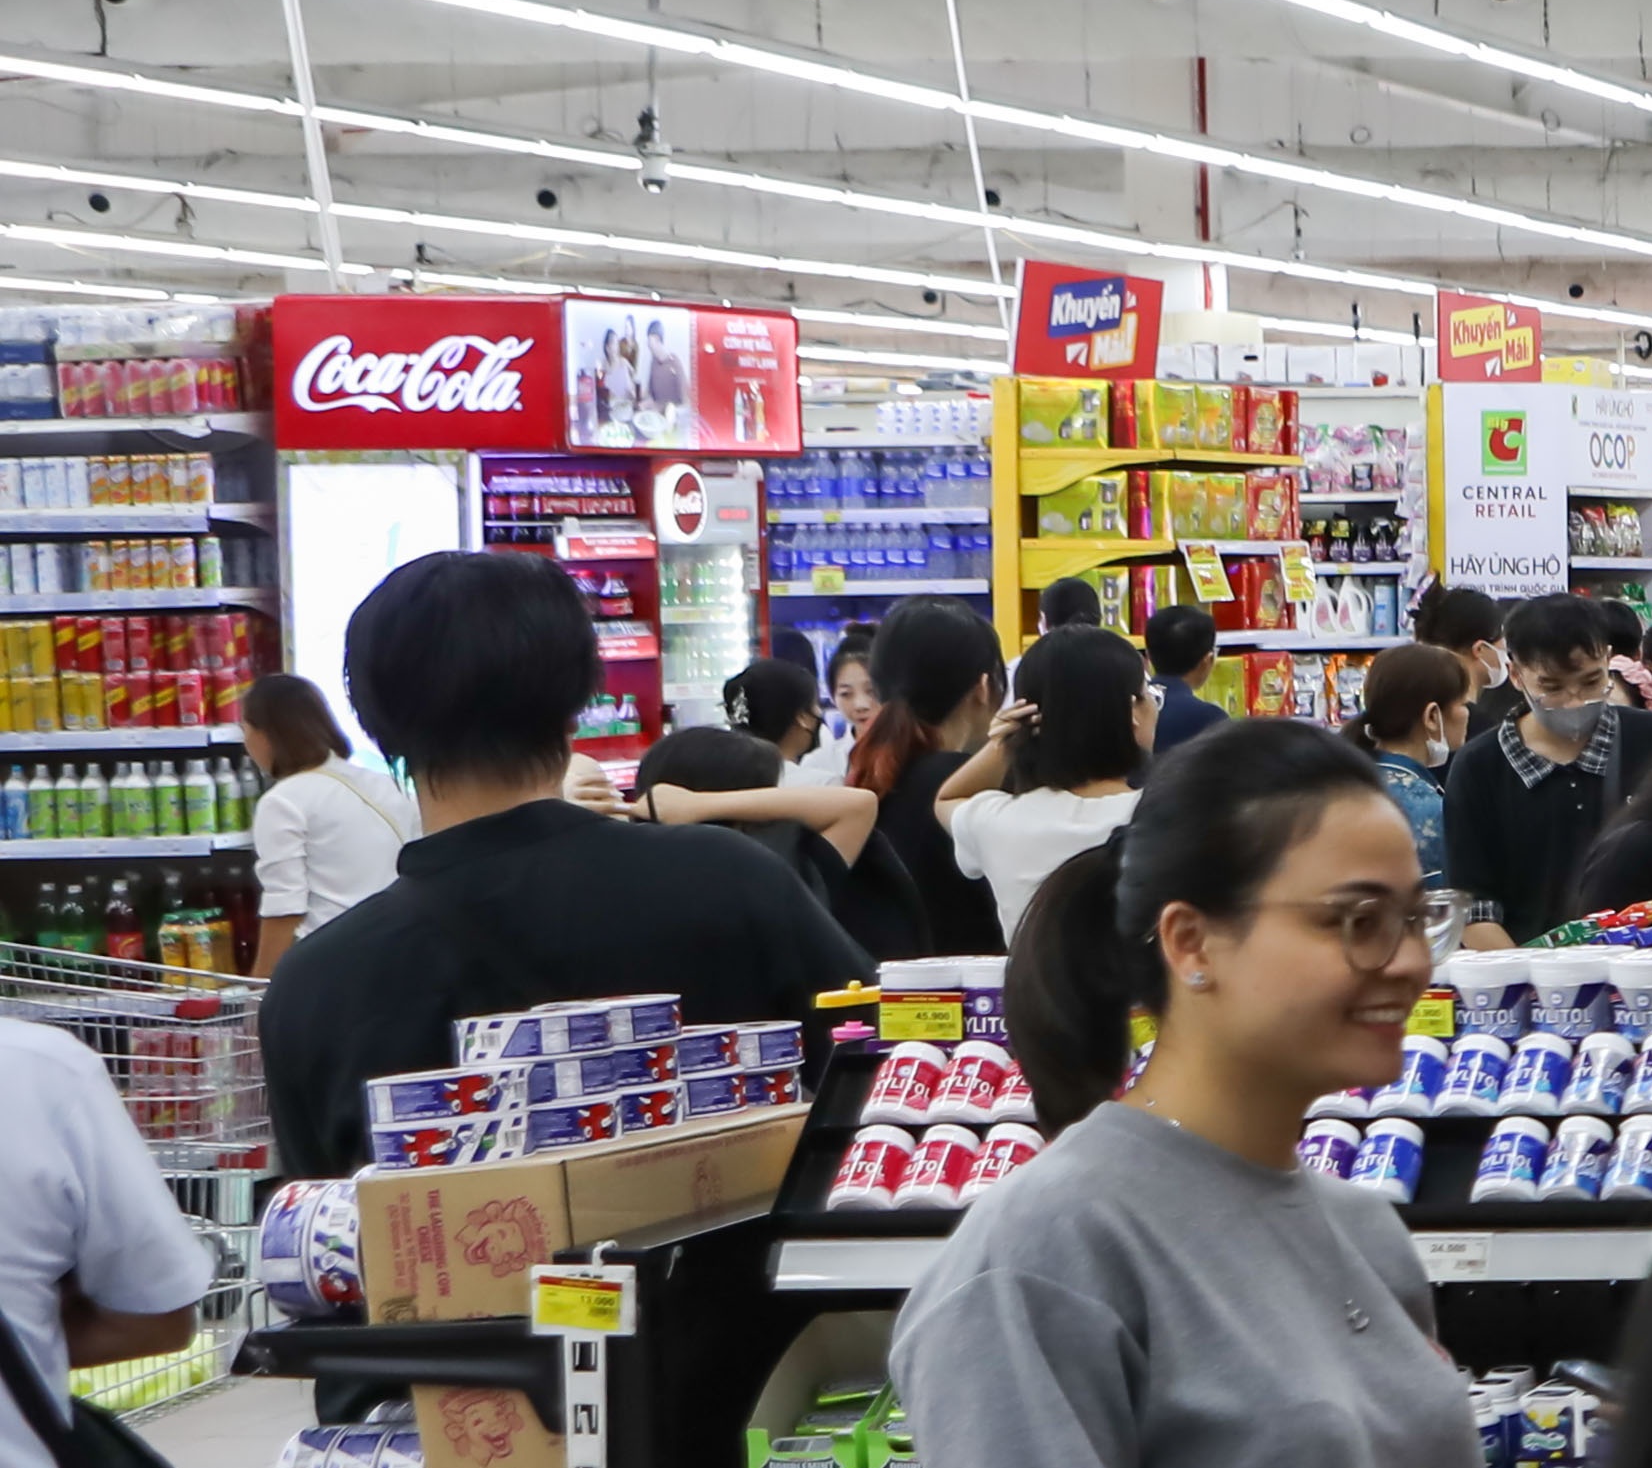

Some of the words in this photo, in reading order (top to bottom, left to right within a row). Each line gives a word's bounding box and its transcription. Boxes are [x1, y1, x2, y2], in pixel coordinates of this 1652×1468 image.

[1453, 313, 1502, 346] Khuyến
[1589, 432, 1636, 468] OCOP
[1463, 486, 1547, 500] CENTRAL
[1475, 504, 1537, 518] RETAIL
[1451, 556, 1486, 576] HÃY
[1532, 554, 1562, 581] HỘ
[1454, 1007, 1519, 1027] XYLITOL
[1531, 1007, 1594, 1027] XYLITOL
